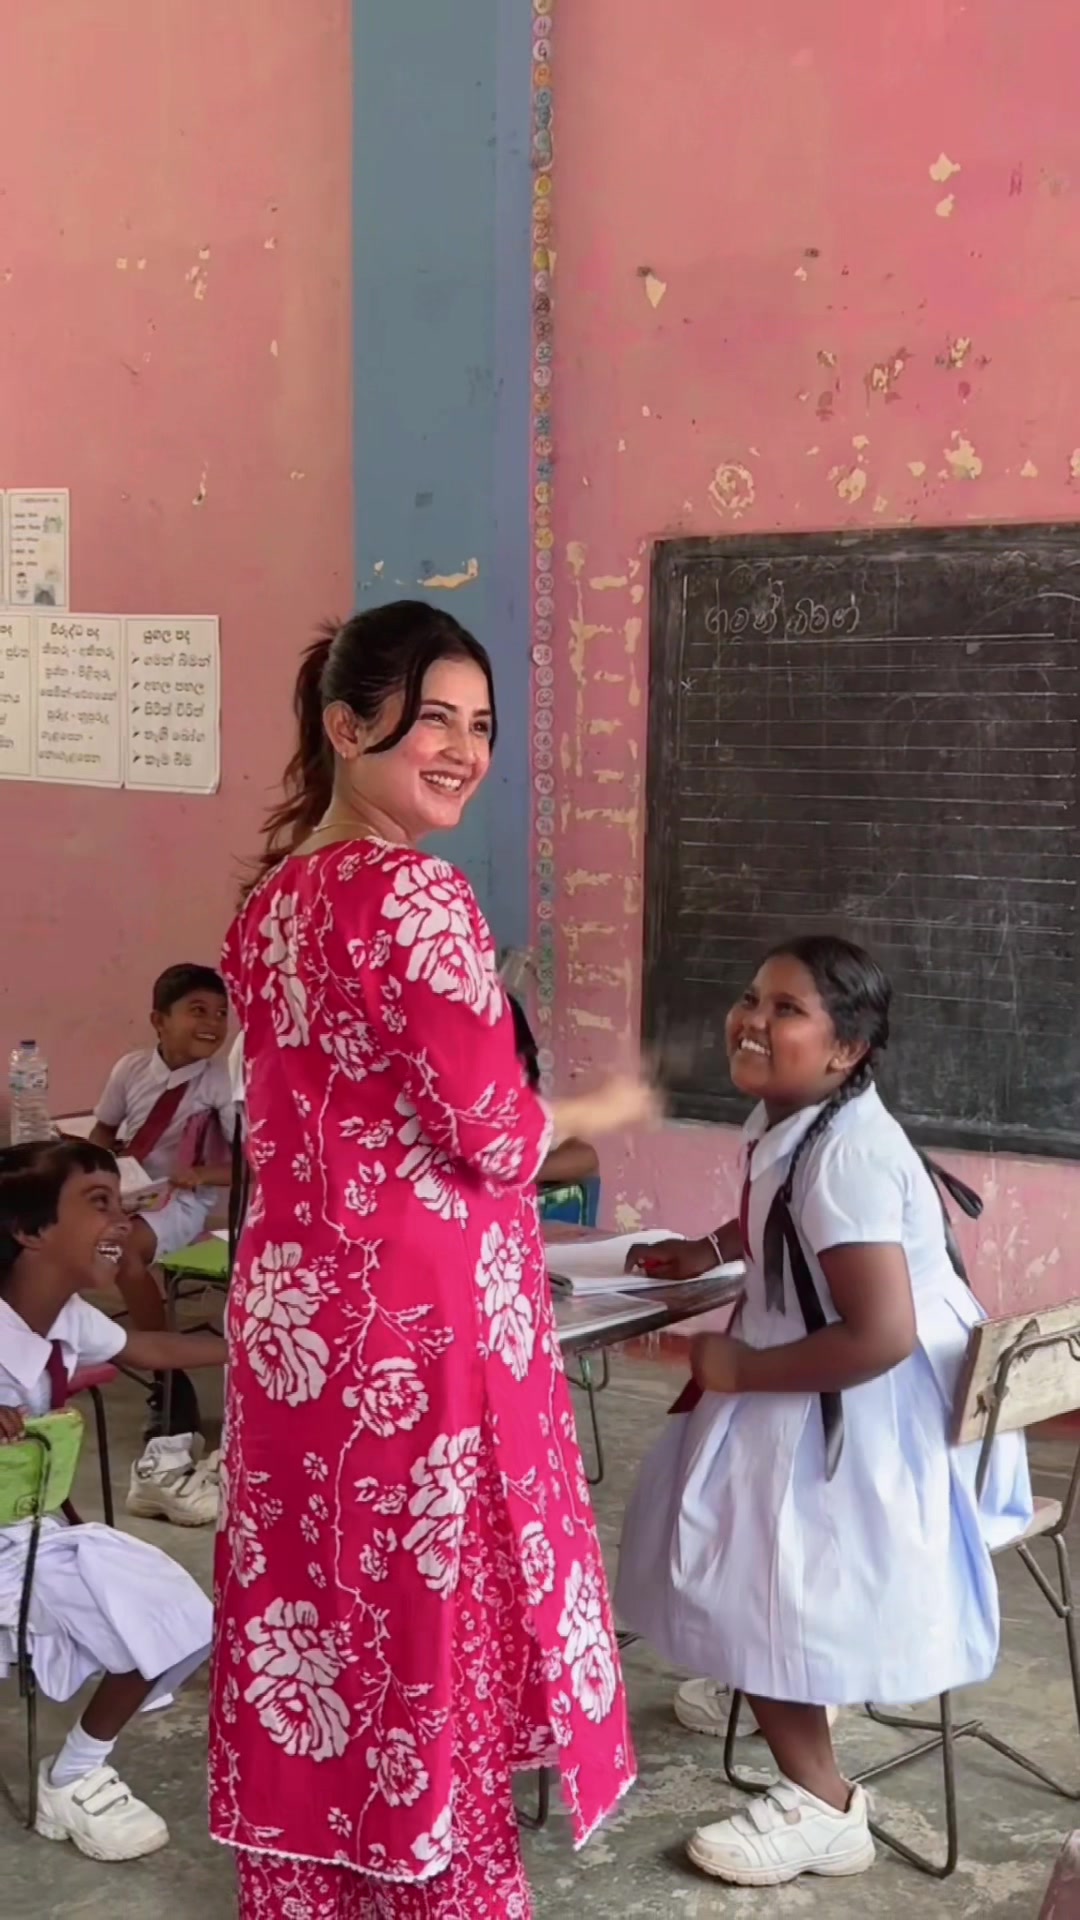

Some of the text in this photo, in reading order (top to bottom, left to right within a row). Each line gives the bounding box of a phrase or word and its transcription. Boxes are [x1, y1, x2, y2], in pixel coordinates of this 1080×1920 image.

[705, 590, 860, 635] ගමන් බිමන්
[87, 628, 100, 641] පද
[175, 630, 191, 645] පද
[144, 652, 212, 668] ගමන් බිමන්
[535, 649, 551, 662] 58
[537, 690, 553, 703] 62
